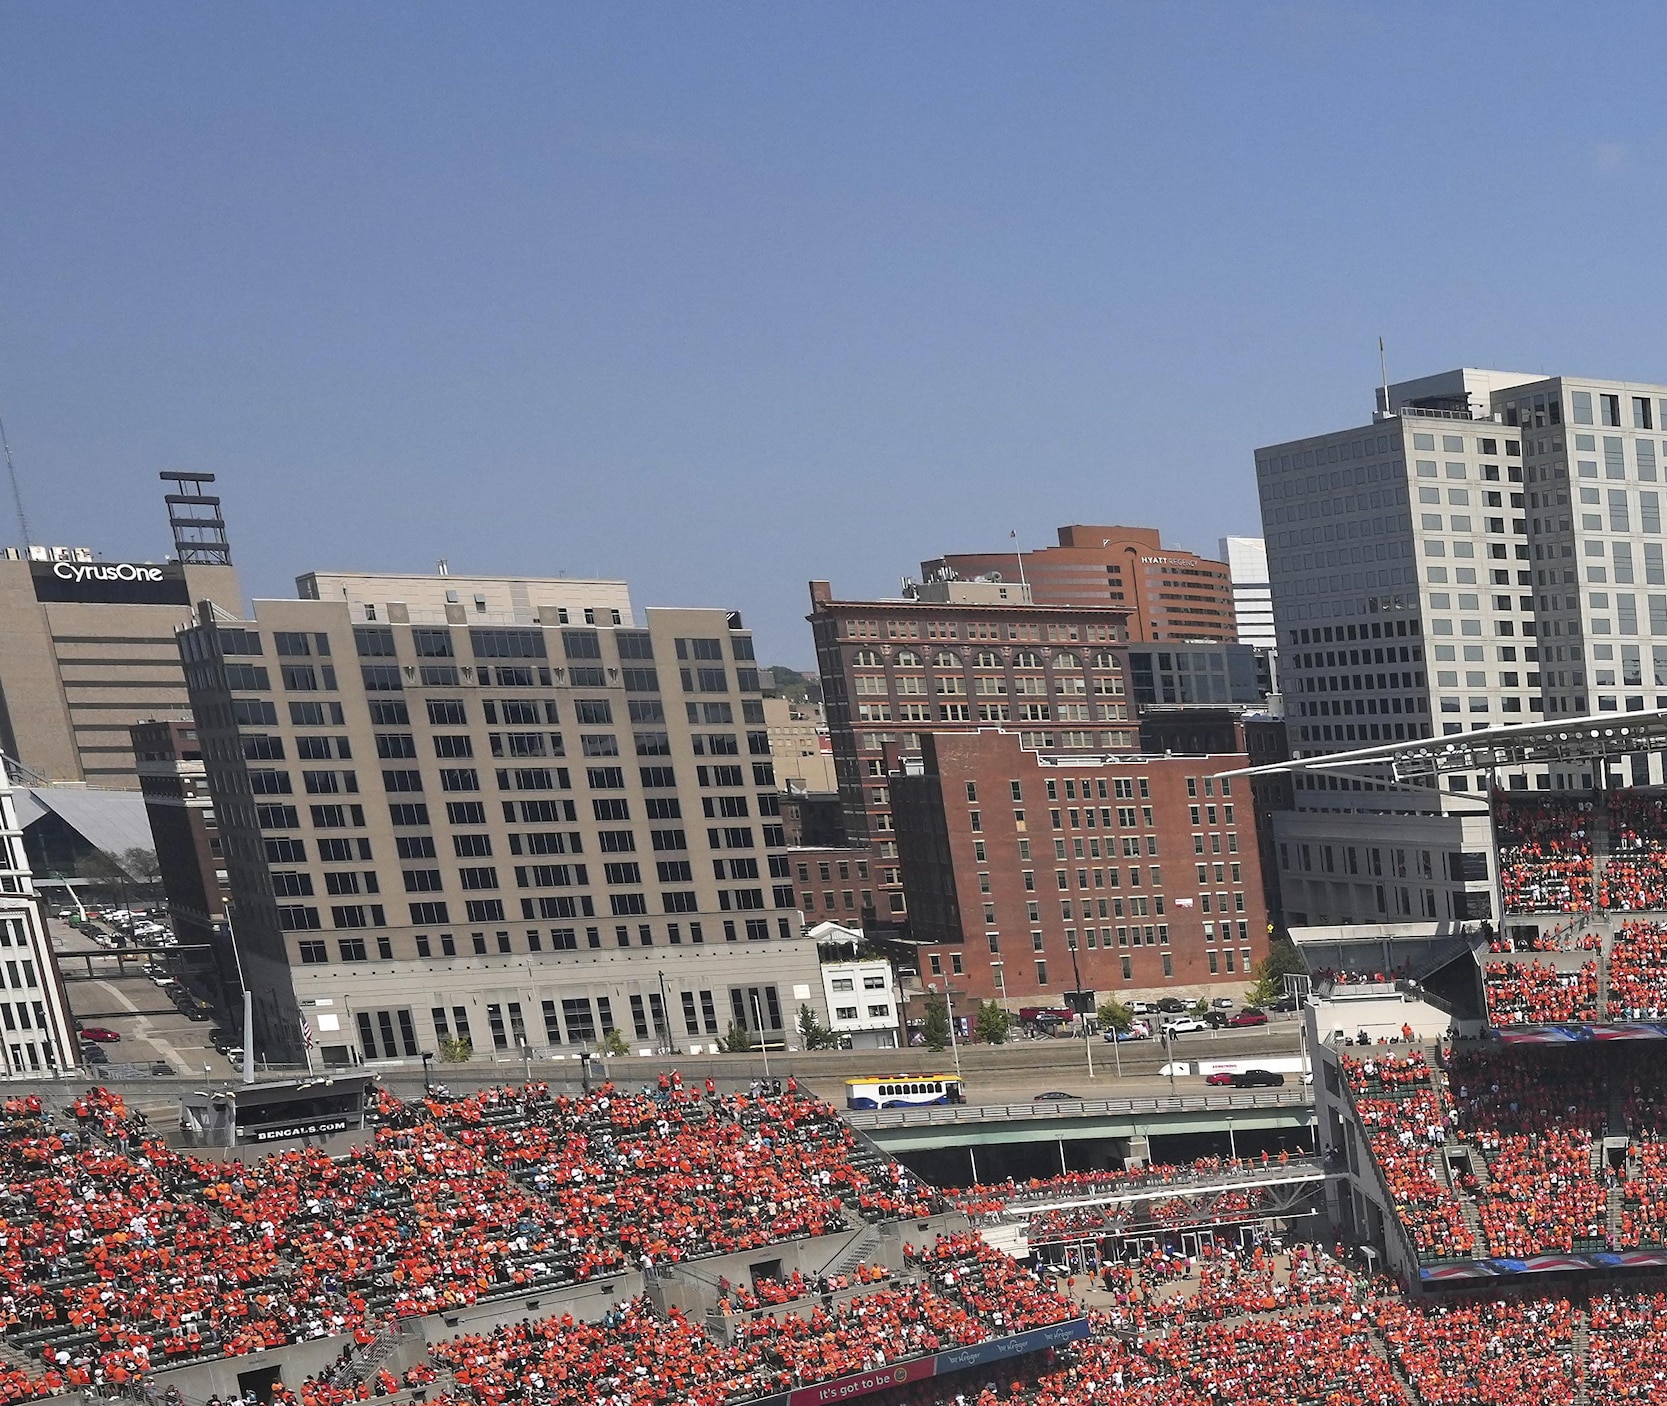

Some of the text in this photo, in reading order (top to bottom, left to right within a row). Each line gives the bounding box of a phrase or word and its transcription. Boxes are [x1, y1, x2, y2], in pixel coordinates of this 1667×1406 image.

[53, 562, 163, 582] CyrusOne
[258, 1122, 345, 1139] BENGALS.COM
[819, 1375, 891, 1400] It's got to be
